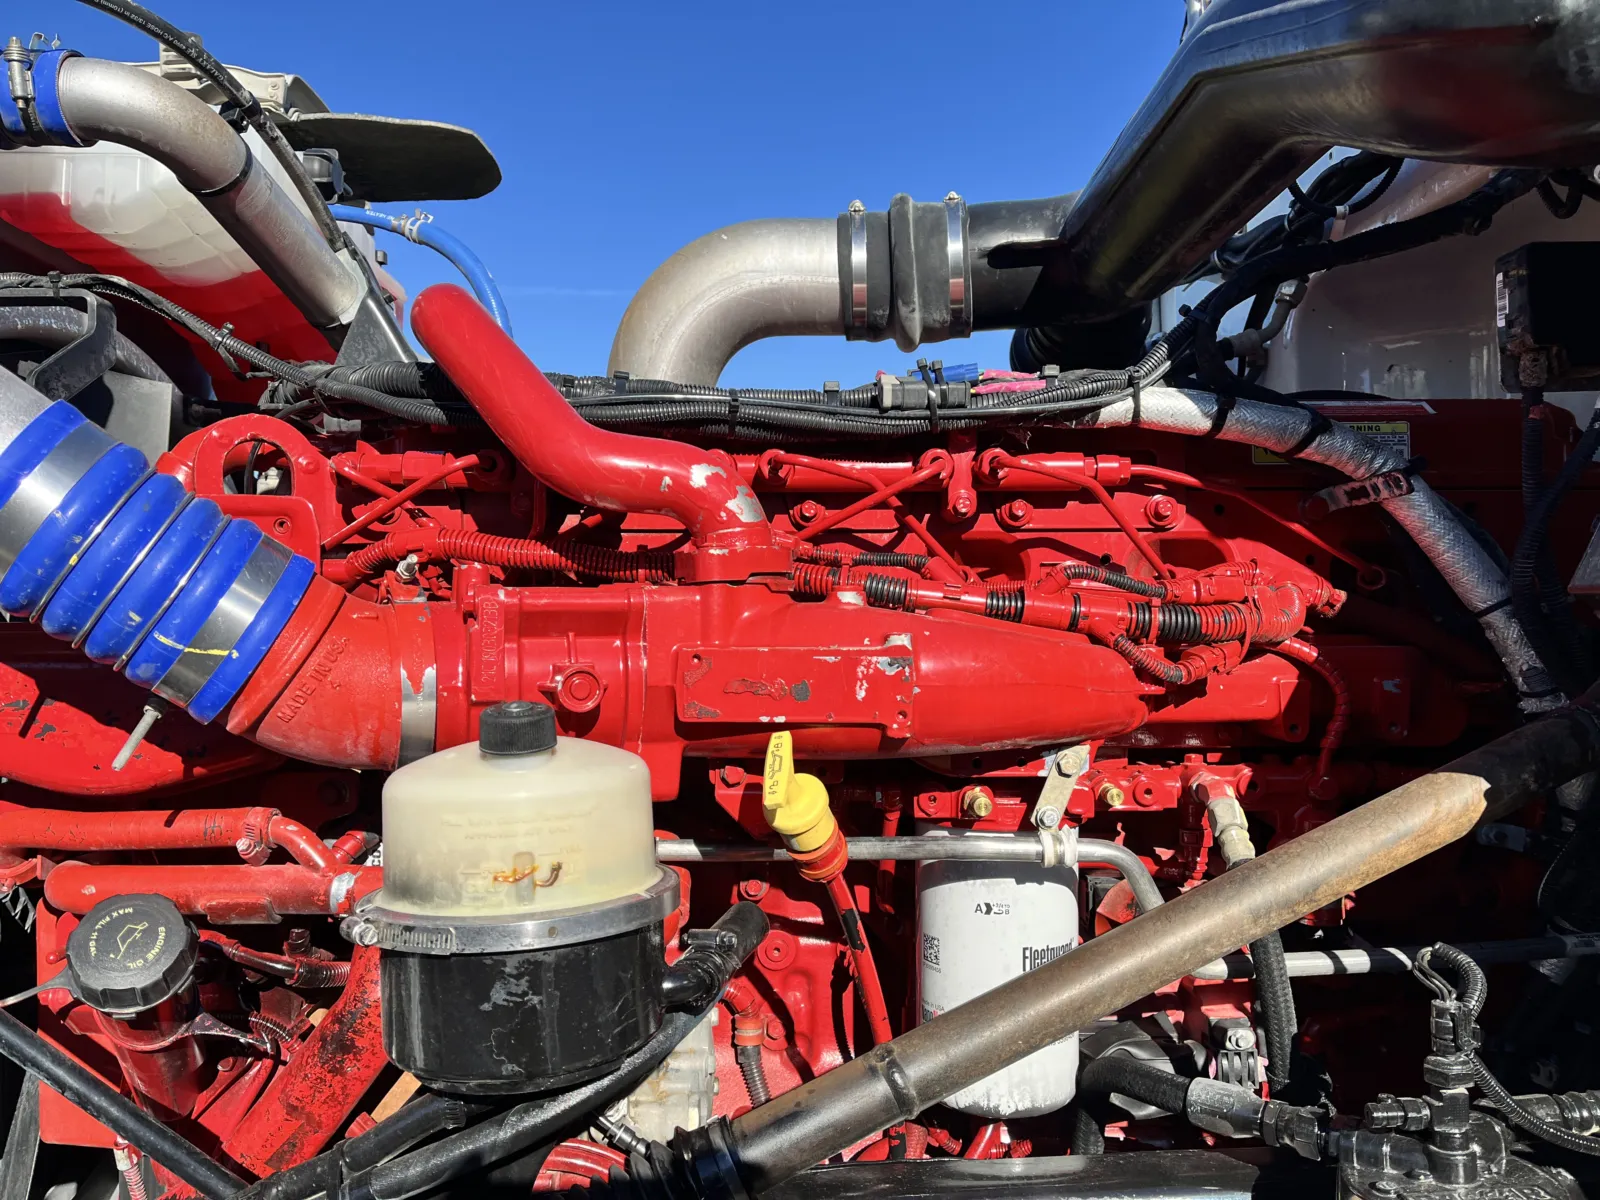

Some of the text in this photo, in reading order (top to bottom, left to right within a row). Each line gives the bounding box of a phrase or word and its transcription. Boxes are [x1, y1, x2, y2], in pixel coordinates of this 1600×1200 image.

[130, 13, 146, 25] 13/32
[146, 22, 164, 36] HOSE
[163, 32, 174, 42] A/C
[198, 57, 225, 84] GALAXY
[276, 636, 350, 724] MADE IN USA
[974, 903, 984, 914] A
[89, 907, 134, 957] MAX FILL 11 GAL
[126, 926, 166, 969] ENGINE OIL
